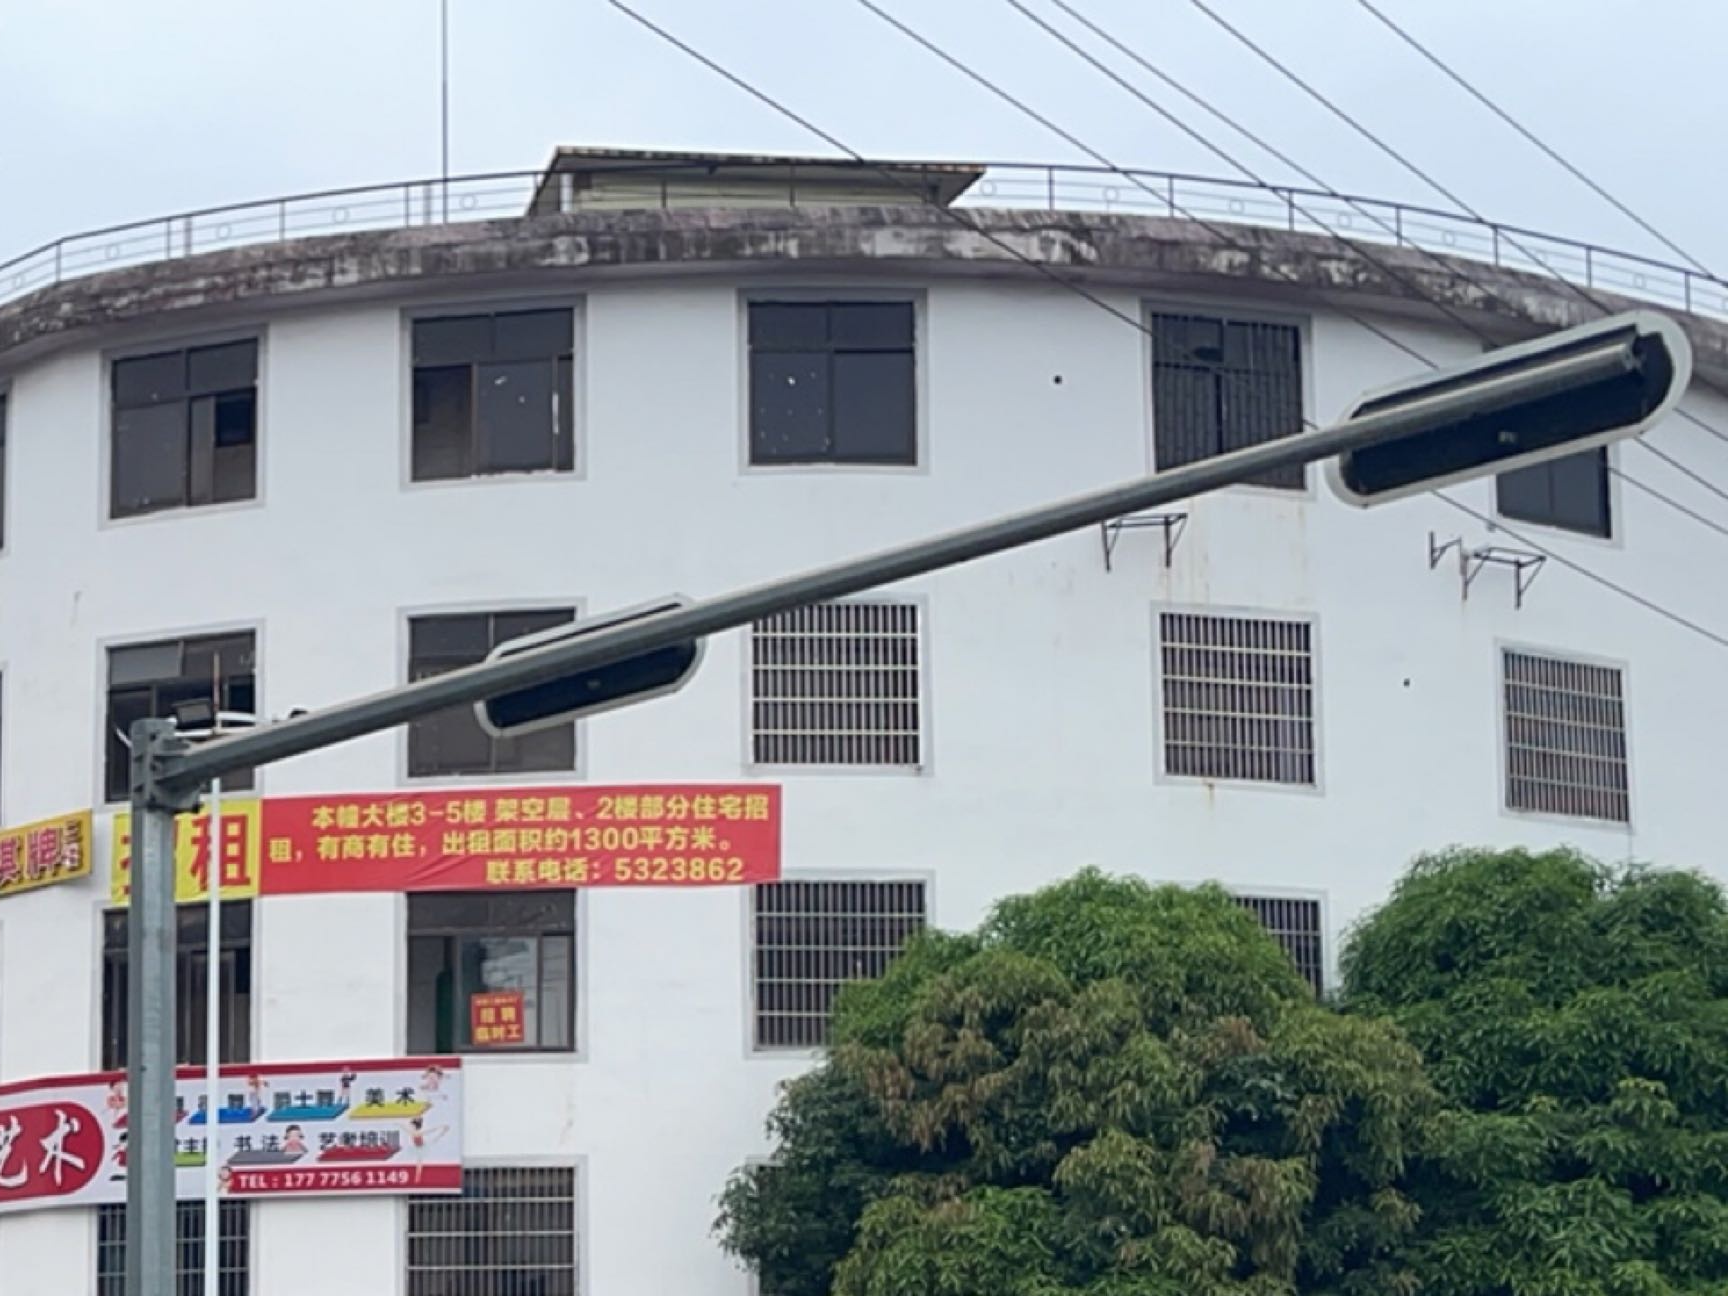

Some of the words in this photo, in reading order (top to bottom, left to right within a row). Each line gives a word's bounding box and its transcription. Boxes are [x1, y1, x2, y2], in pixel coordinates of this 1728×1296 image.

[285, 1172, 315, 1188] 177
[321, 1171, 360, 1187] 7756
[366, 1169, 409, 1185] 1149
